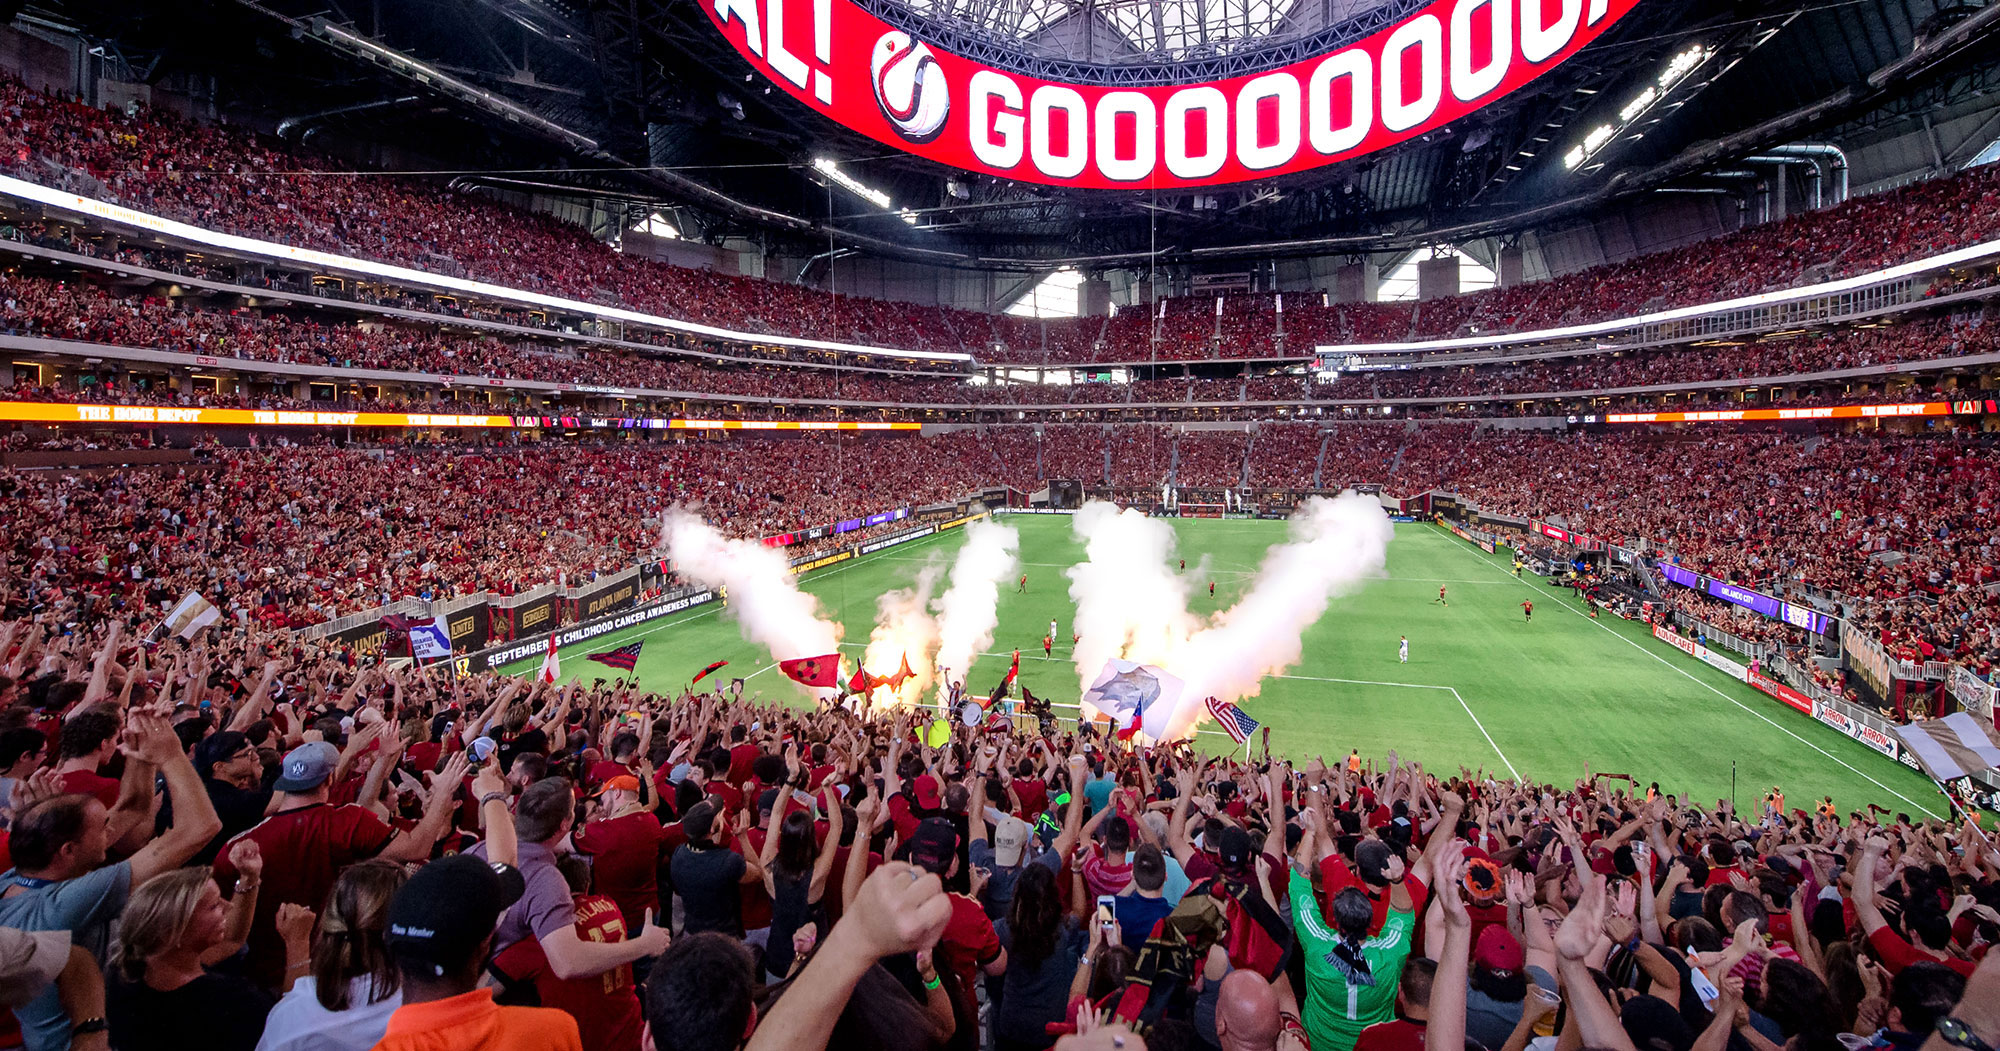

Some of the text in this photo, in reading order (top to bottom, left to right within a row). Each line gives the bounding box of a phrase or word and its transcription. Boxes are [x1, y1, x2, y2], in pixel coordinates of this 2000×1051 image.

[77, 406, 201, 422] THE HOME DEPOT
[253, 411, 358, 425] THE HOME DEPOT
[1699, 578, 1705, 589] 2
[588, 585, 633, 615] ATLANTA UNITED
[1721, 587, 1754, 605] ORLANDO CITY
[525, 607, 549, 625] CONQUER
[452, 619, 473, 636] UNITE
[487, 639, 549, 666] SEPTEMBER
[563, 619, 613, 644] CHILDHOOD
[614, 611, 646, 628] CANCER
[646, 597, 689, 619] AWARENESS
[690, 591, 713, 606] MONTH
[1656, 627, 1692, 653] ADVOCARE
[1823, 708, 1847, 727] ARROW
[1861, 727, 1889, 748] ARROW
[1899, 755, 1920, 771] adidas
[576, 898, 618, 925] ATLANTA
[406, 925, 435, 939] Member
